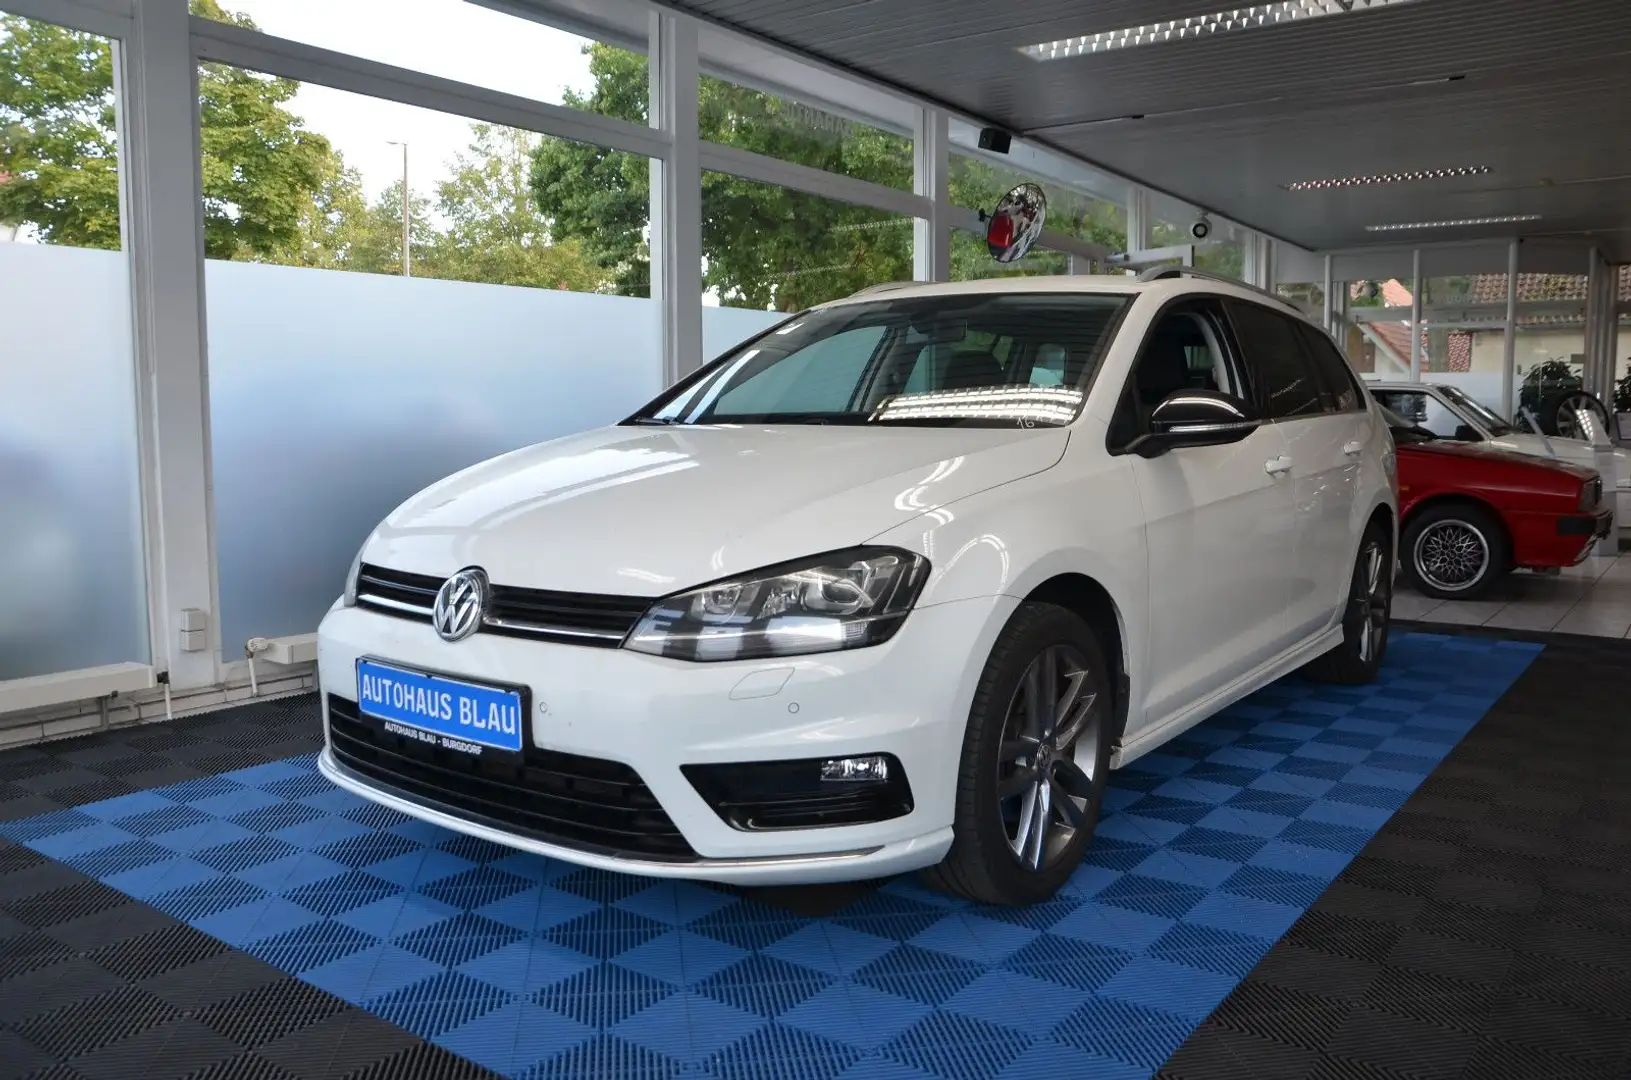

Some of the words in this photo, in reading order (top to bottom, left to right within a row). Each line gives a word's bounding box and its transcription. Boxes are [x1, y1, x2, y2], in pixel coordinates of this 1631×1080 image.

[362, 675, 452, 720] AUTOHAUS
[459, 696, 516, 735] BLAU
[385, 722, 417, 739] AUTOHAUS
[419, 732, 436, 744] BLAU
[442, 740, 482, 755] BURGDORF
